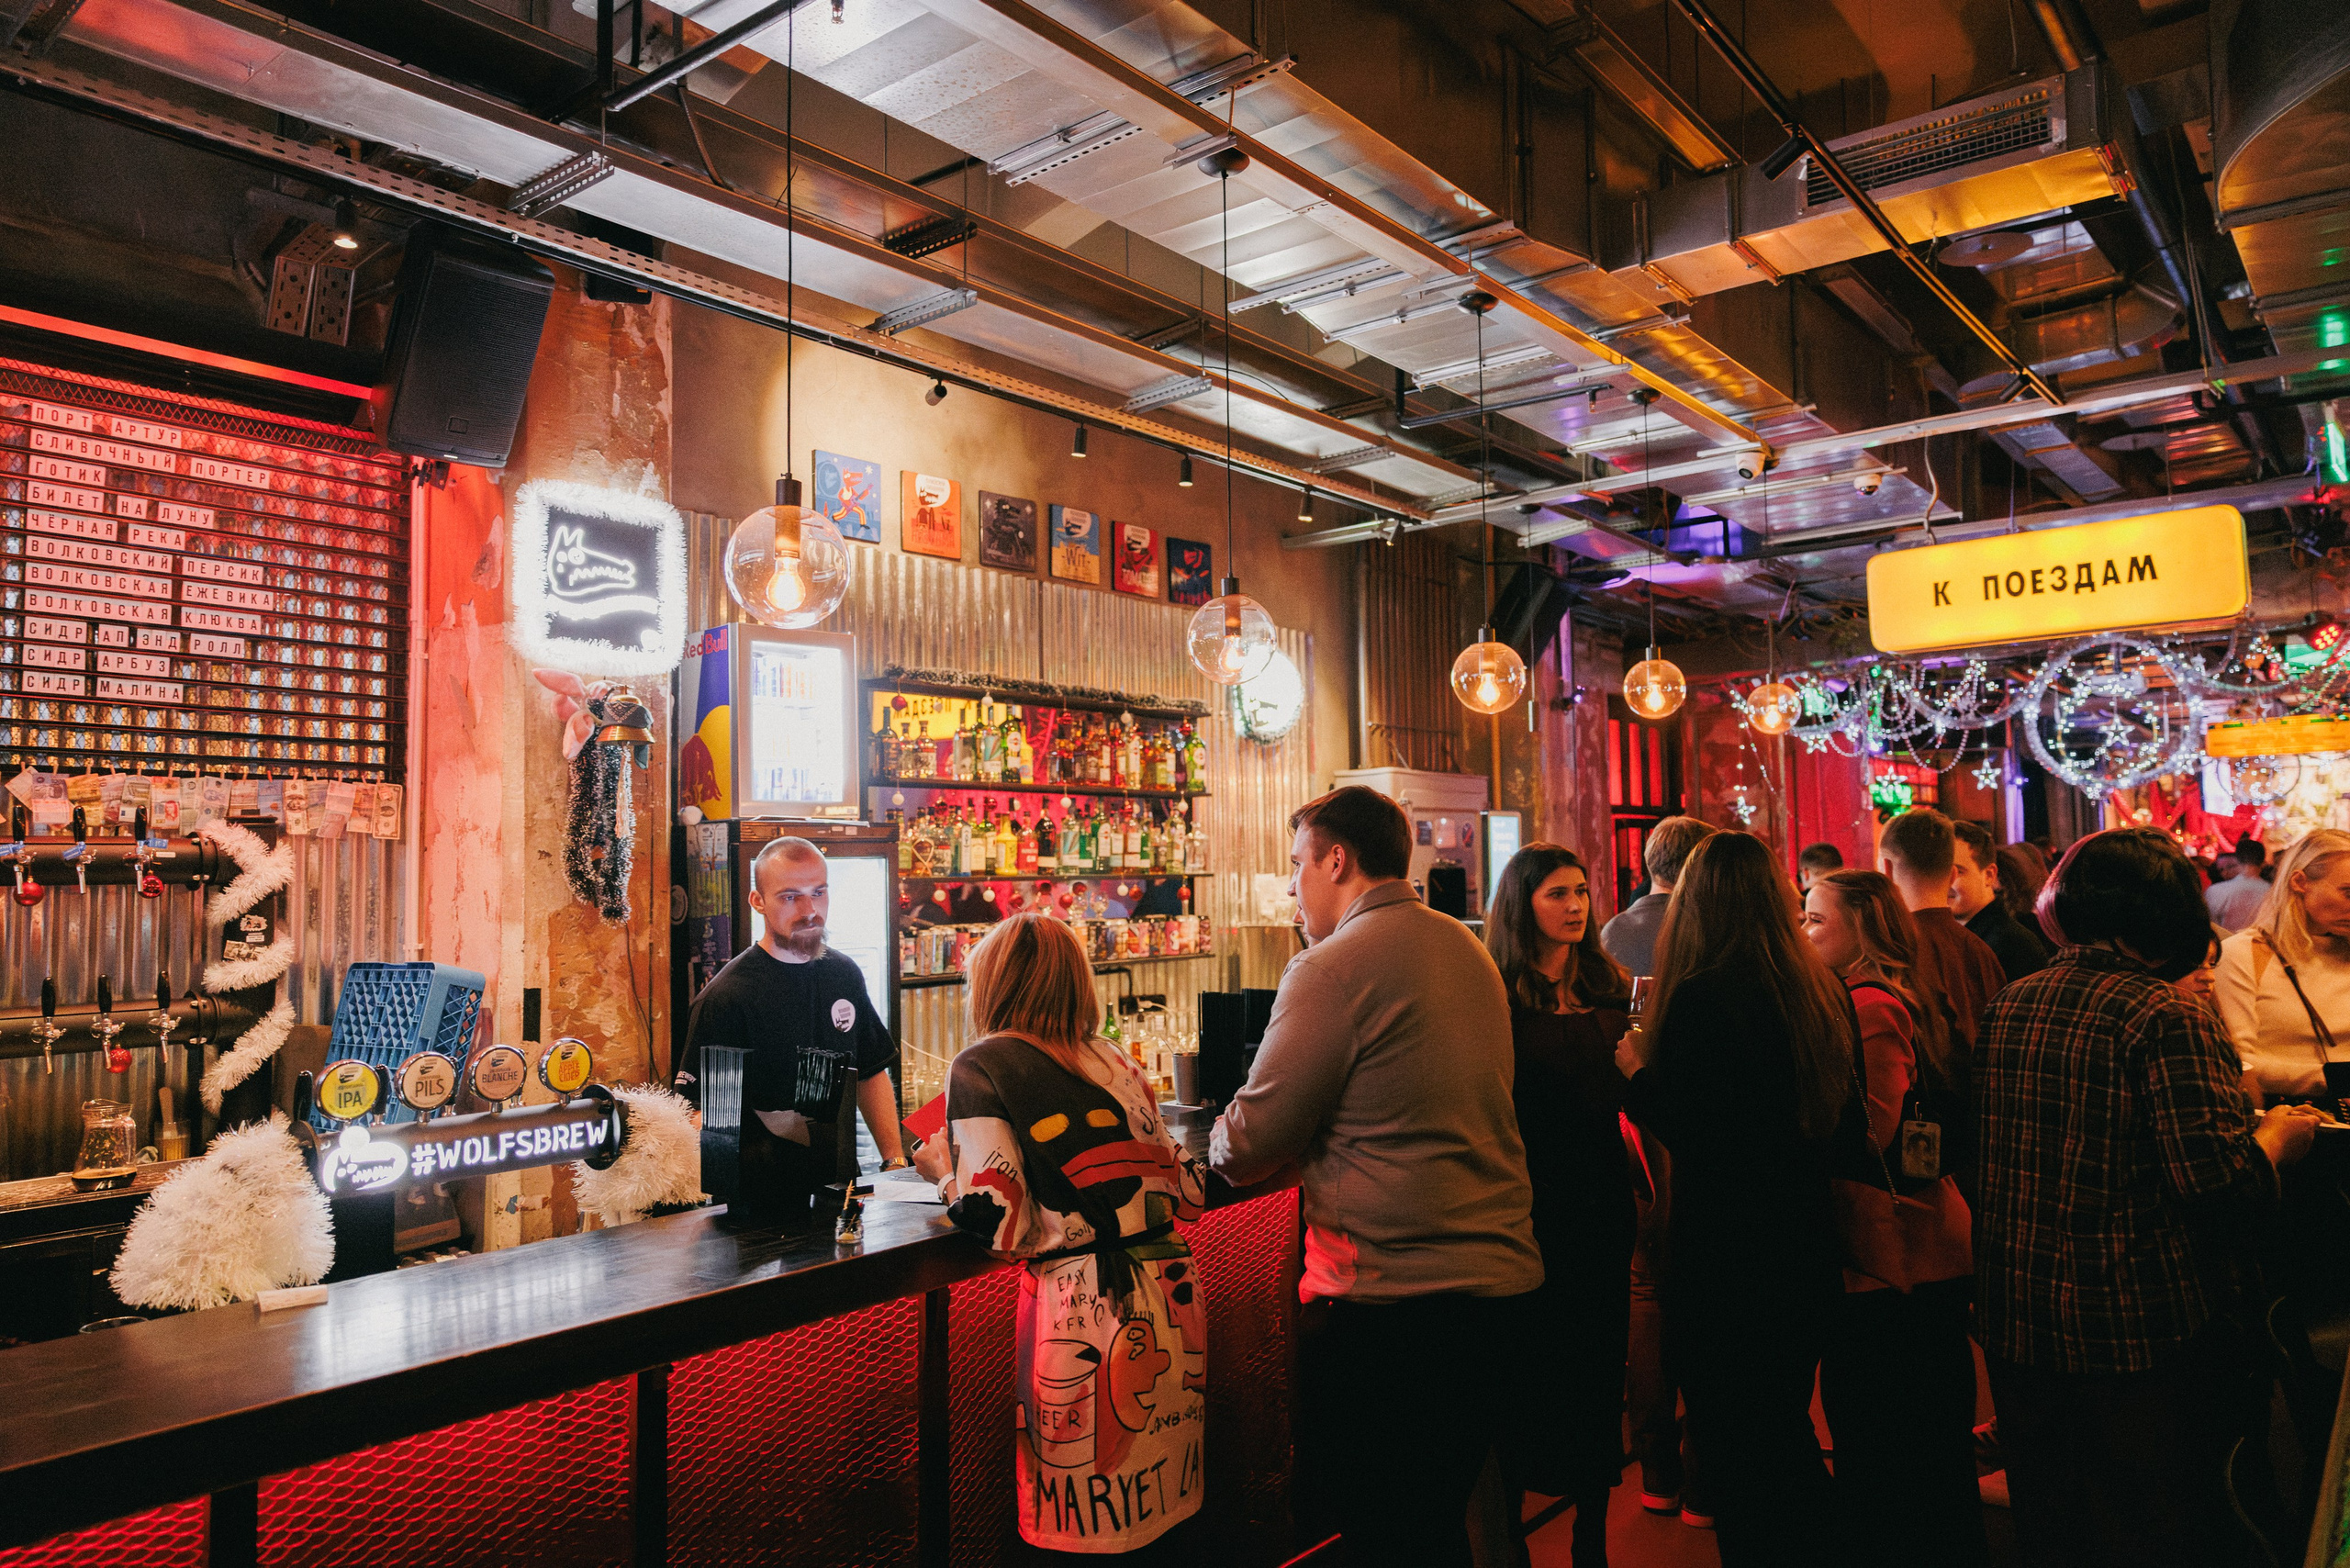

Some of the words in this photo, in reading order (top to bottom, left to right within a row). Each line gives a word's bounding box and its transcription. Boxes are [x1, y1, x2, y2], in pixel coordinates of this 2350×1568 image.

[36, 407, 89, 428] ПОРТ
[115, 421, 177, 443] АРТУР
[35, 433, 172, 468] СЛИВОЧНЫЙ
[196, 463, 266, 484] ПОРТЕР
[35, 461, 101, 482] ГОТИК
[32, 487, 99, 508] БИЛЕТ
[121, 501, 142, 515] НА
[162, 508, 210, 525] ЛУНУ
[31, 513, 113, 536] ЧЁРНАЯ
[132, 529, 182, 546] РЕКА
[31, 540, 168, 569] ВОЛКОВСКИЙ
[187, 561, 259, 581] ПЕРСИК
[31, 566, 168, 594] ВОЛКОВСКАЯ
[186, 585, 270, 605] ЕЖЕВИКА
[1933, 580, 1952, 607] К
[1983, 554, 2159, 601] ПОЕЗДАМ
[29, 594, 168, 620] ВОЛКОВСКАЯ
[185, 611, 257, 631] КЛЮКВА
[29, 622, 83, 640] СИДР
[103, 631, 124, 643] АП
[142, 634, 177, 650] ЭНД
[194, 639, 241, 655] РОЛЛ
[705, 628, 728, 655] Bull
[28, 648, 81, 666] СИДР
[102, 655, 165, 672] АРБУЗ
[27, 675, 80, 691] СИДР
[100, 680, 180, 700] МАЛИНА
[415, 1078, 445, 1098] PILS
[482, 1070, 518, 1083] BLANCHE
[338, 1091, 363, 1109] IPA
[411, 1119, 609, 1176] #WOLFSBREW
[1058, 1269, 1086, 1292] EASY
[1059, 1294, 1097, 1310] MARY
[1036, 1405, 1081, 1429] EER
